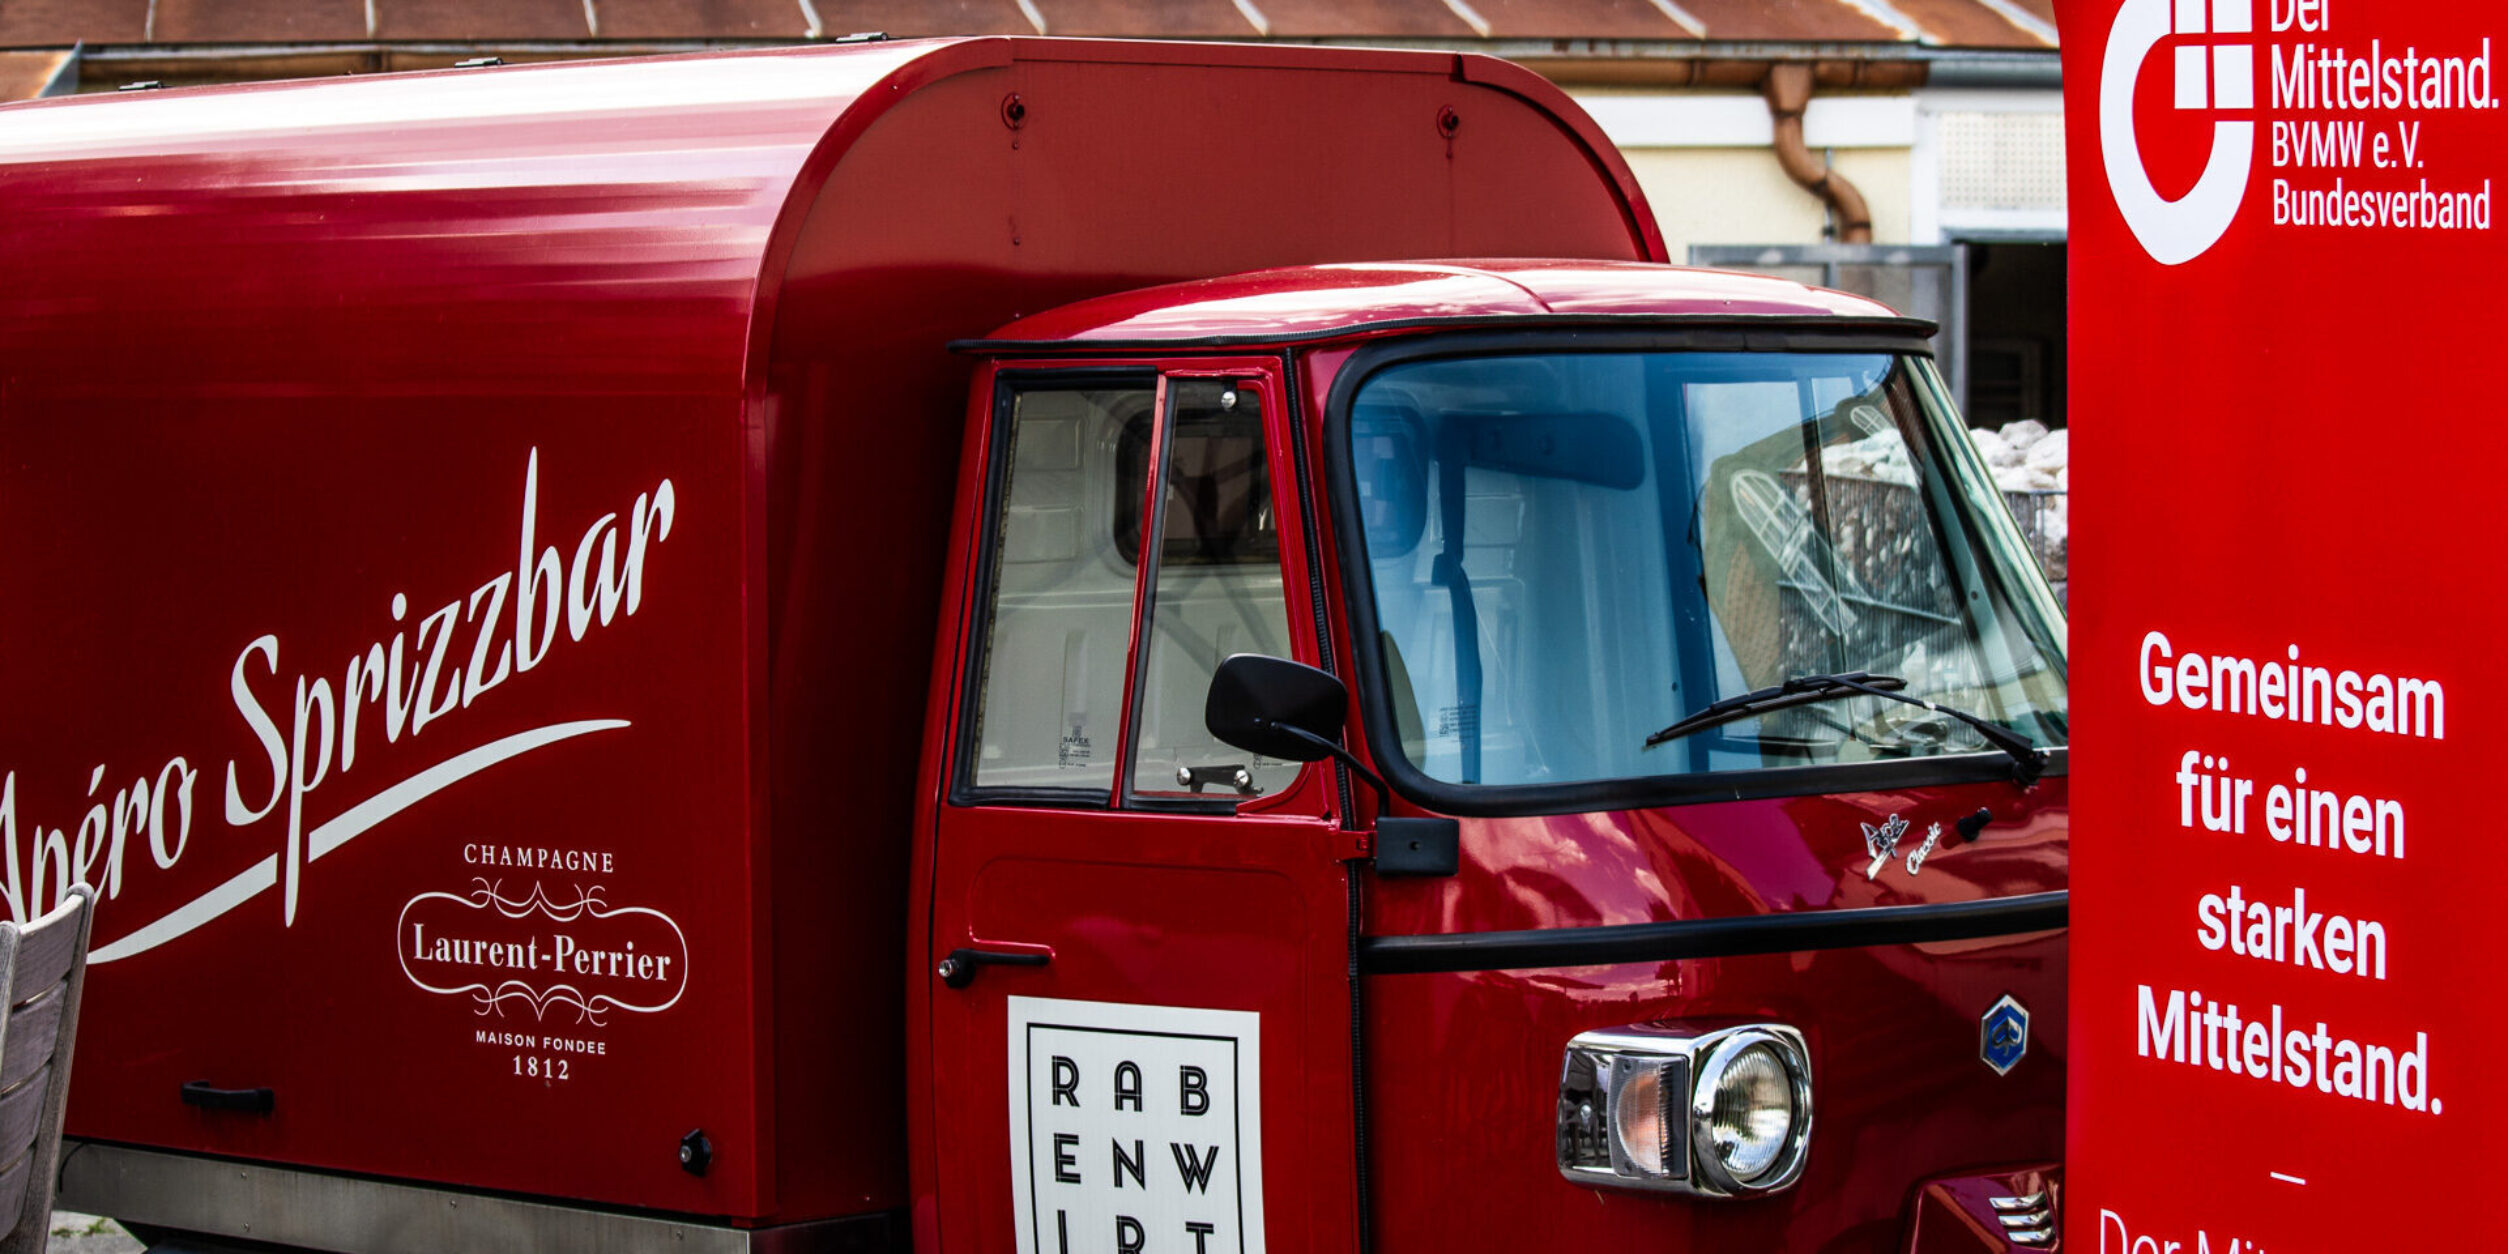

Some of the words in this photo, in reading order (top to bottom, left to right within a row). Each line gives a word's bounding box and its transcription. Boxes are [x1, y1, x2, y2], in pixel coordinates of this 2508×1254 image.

[2271, 37, 2500, 110] Mittelstand.
[2272, 120, 2364, 168] BVMW
[2372, 120, 2424, 169] e.V.
[2273, 176, 2490, 230] Bundesverband
[225, 446, 675, 928] Sprizzbar
[2139, 630, 2444, 740] Gemeinsam
[2175, 750, 2253, 835] für
[2265, 767, 2405, 859] einen
[464, 843, 615, 873] CHAMPAGNE
[413, 922, 672, 982] Laurent-Perrier
[2197, 885, 2387, 981] starken
[476, 1030, 536, 1049] MAISON
[543, 1037, 607, 1055] FONDEE
[512, 1054, 570, 1080] 1812
[2137, 984, 2443, 1115] Mittelstand.
